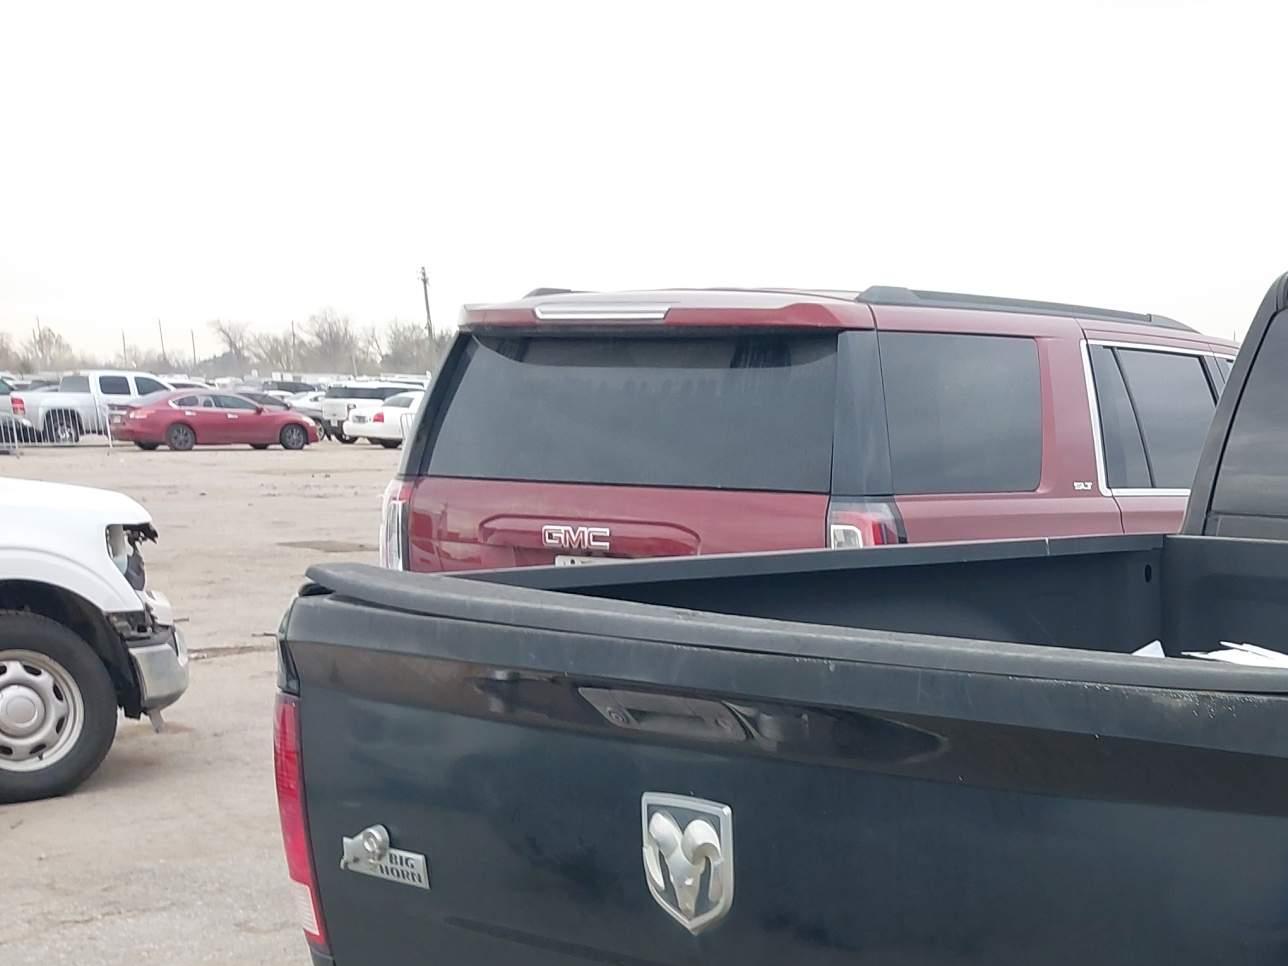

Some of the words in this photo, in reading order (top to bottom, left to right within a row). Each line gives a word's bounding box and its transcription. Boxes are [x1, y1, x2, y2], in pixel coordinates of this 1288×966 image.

[541, 525, 610, 552] GMC
[388, 853, 416, 869] BIG
[379, 863, 423, 884] HORN
